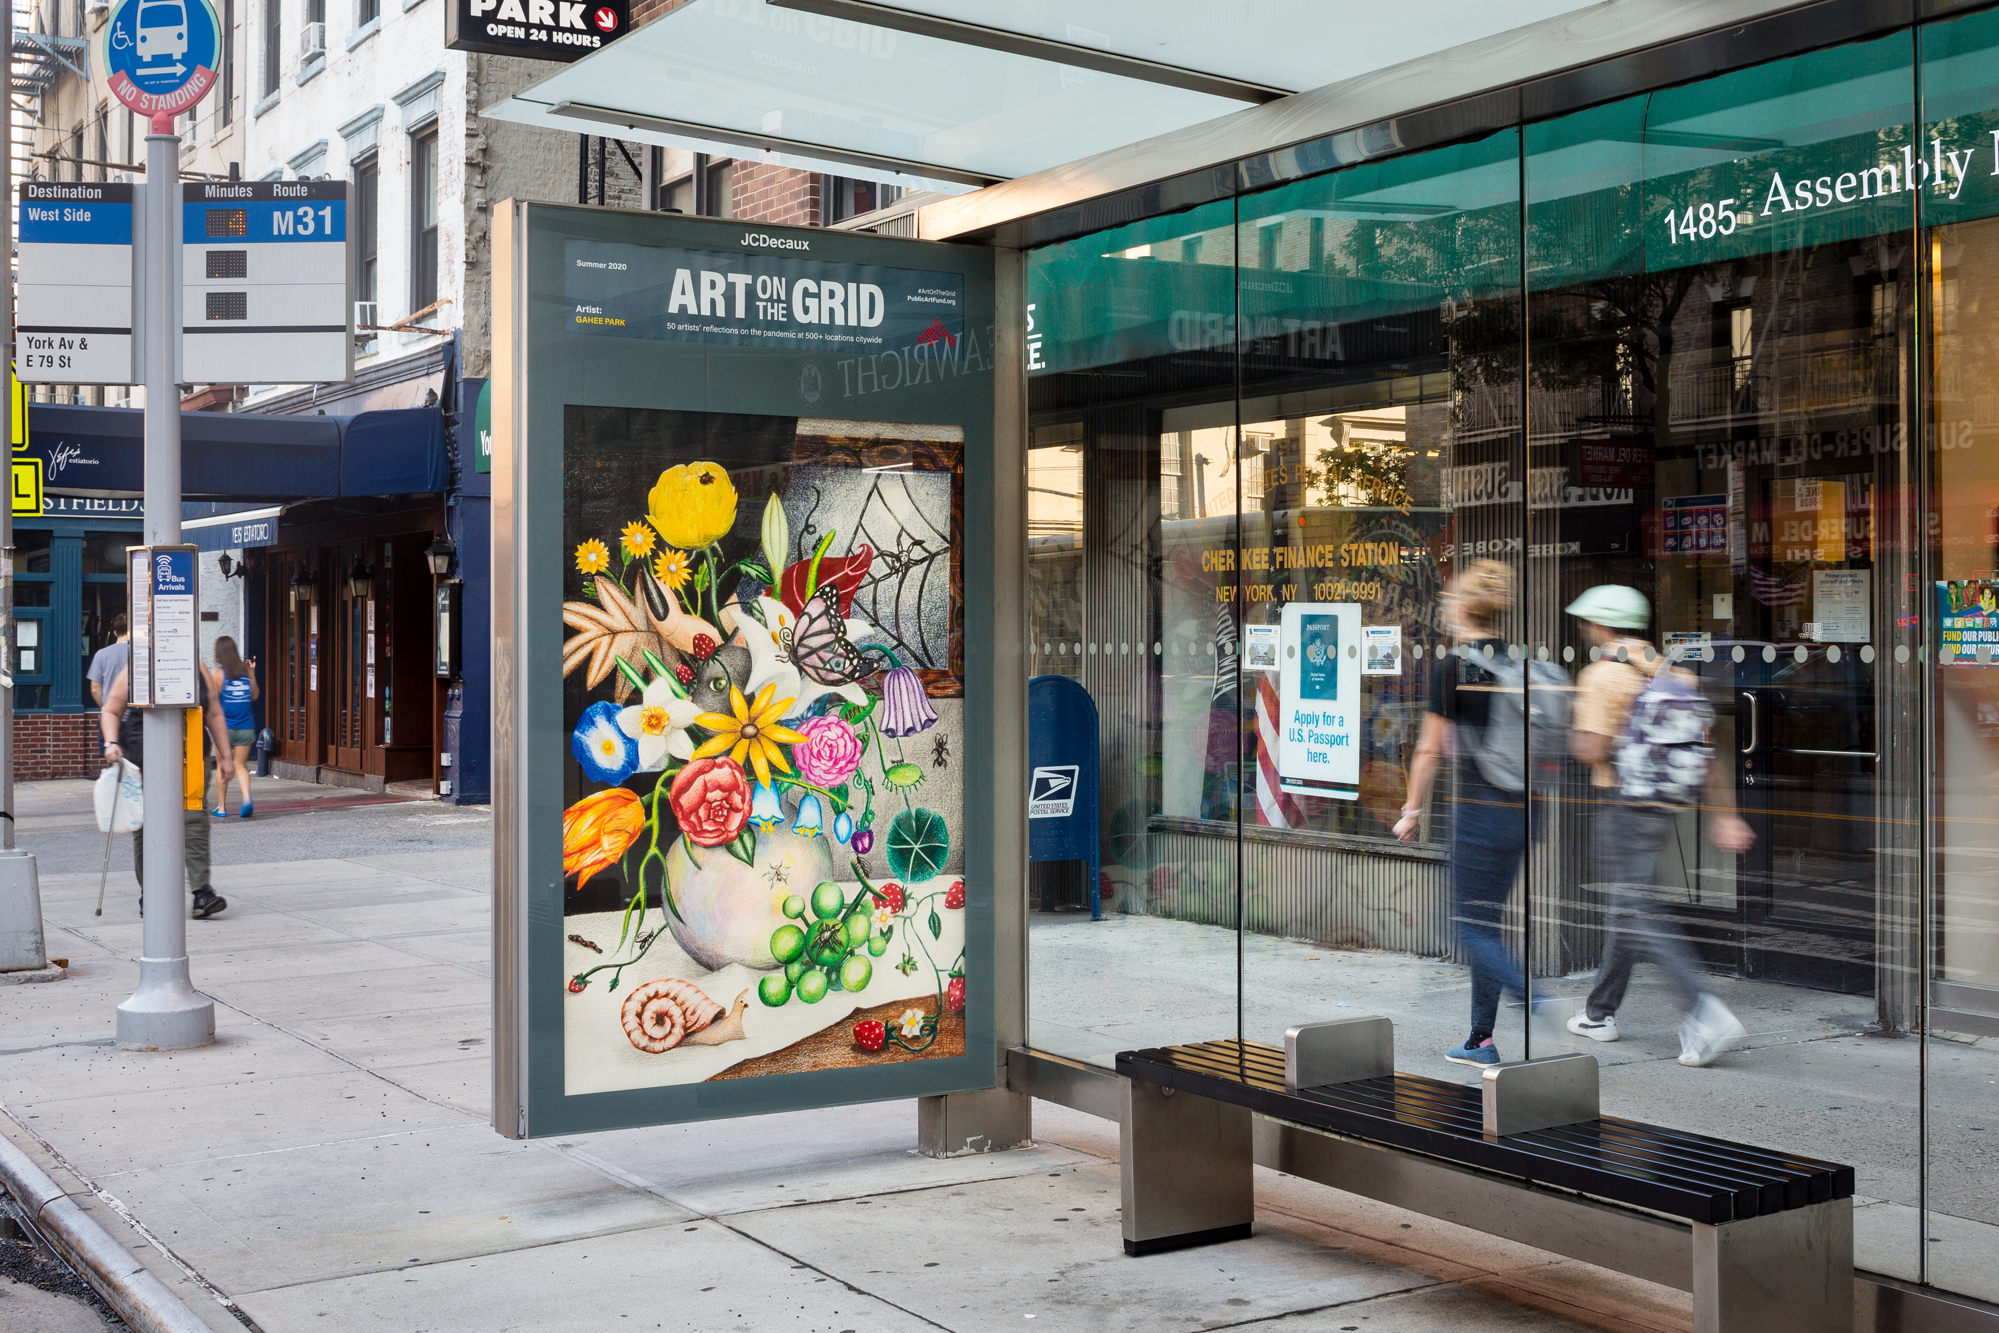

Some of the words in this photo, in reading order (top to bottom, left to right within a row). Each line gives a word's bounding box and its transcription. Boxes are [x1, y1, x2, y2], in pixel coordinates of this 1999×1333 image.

[470, 0, 588, 30] PARK
[486, 23, 526, 39] OPEN
[529, 29, 548, 42] 24
[552, 31, 601, 48] HOURS
[117, 79, 137, 102] NO
[140, 73, 207, 111] STANDING
[28, 185, 102, 199] Destination
[205, 185, 253, 198] Minutes
[273, 184, 308, 197] Route
[1664, 198, 1736, 244] 1485
[1760, 138, 1975, 217] Assembly
[28, 209, 61, 222] West
[64, 209, 91, 222] Side
[273, 206, 332, 236] M31
[740, 232, 810, 251] JCDecaux
[576, 259, 606, 270] Summer
[608, 262, 627, 271] 2020
[668, 268, 753, 317] ART
[756, 274, 786, 301] ON
[918, 288, 956, 298] #ArtOnTheGrid
[792, 278, 884, 328] GRID
[907, 295, 956, 306] PublicArtFund.org
[576, 305, 602, 315] Artist:
[756, 301, 787, 323] THE
[576, 316, 604, 326] GAHEE
[604, 317, 626, 327] PARK
[667, 322, 676, 330] 50
[677, 322, 701, 332] artists'
[703, 324, 739, 334] reflections
[750, 327, 762, 336] the
[763, 328, 796, 340] pandemic
[797, 331, 804, 339] at
[805, 331, 823, 340] 500+
[825, 332, 854, 342] locations
[855, 334, 883, 345] citywide
[917, 318, 942, 345] PUBLIC
[928, 329, 944, 348] ART
[939, 326, 957, 348] FUND
[27, 336, 55, 350] York
[58, 337, 74, 350] Av
[78, 337, 88, 350] &
[26, 355, 33, 368] E
[38, 355, 54, 368] 79
[58, 355, 72, 368] St
[69, 457, 100, 465] estiatorio
[1201, 547, 1270, 573] CHERKEE
[1275, 545, 1334, 569] FINANCE
[1340, 542, 1399, 567] STATION
[158, 583, 186, 591] Arrivals
[171, 575, 186, 583] Bus
[1245, 584, 1277, 604] YORK,
[1282, 583, 1298, 601] NY
[1312, 581, 1381, 600] 10021-9991
[1942, 630, 1962, 642] FUND
[1962, 630, 1977, 642] OUR
[1962, 643, 1977, 655] OUR
[1294, 710, 1320, 728] Apply
[1322, 711, 1336, 726] for
[1338, 716, 1344, 728] a
[1288, 728, 1306, 743] U.S.
[1308, 729, 1350, 748] Passport
[1307, 748, 1330, 764] here.
